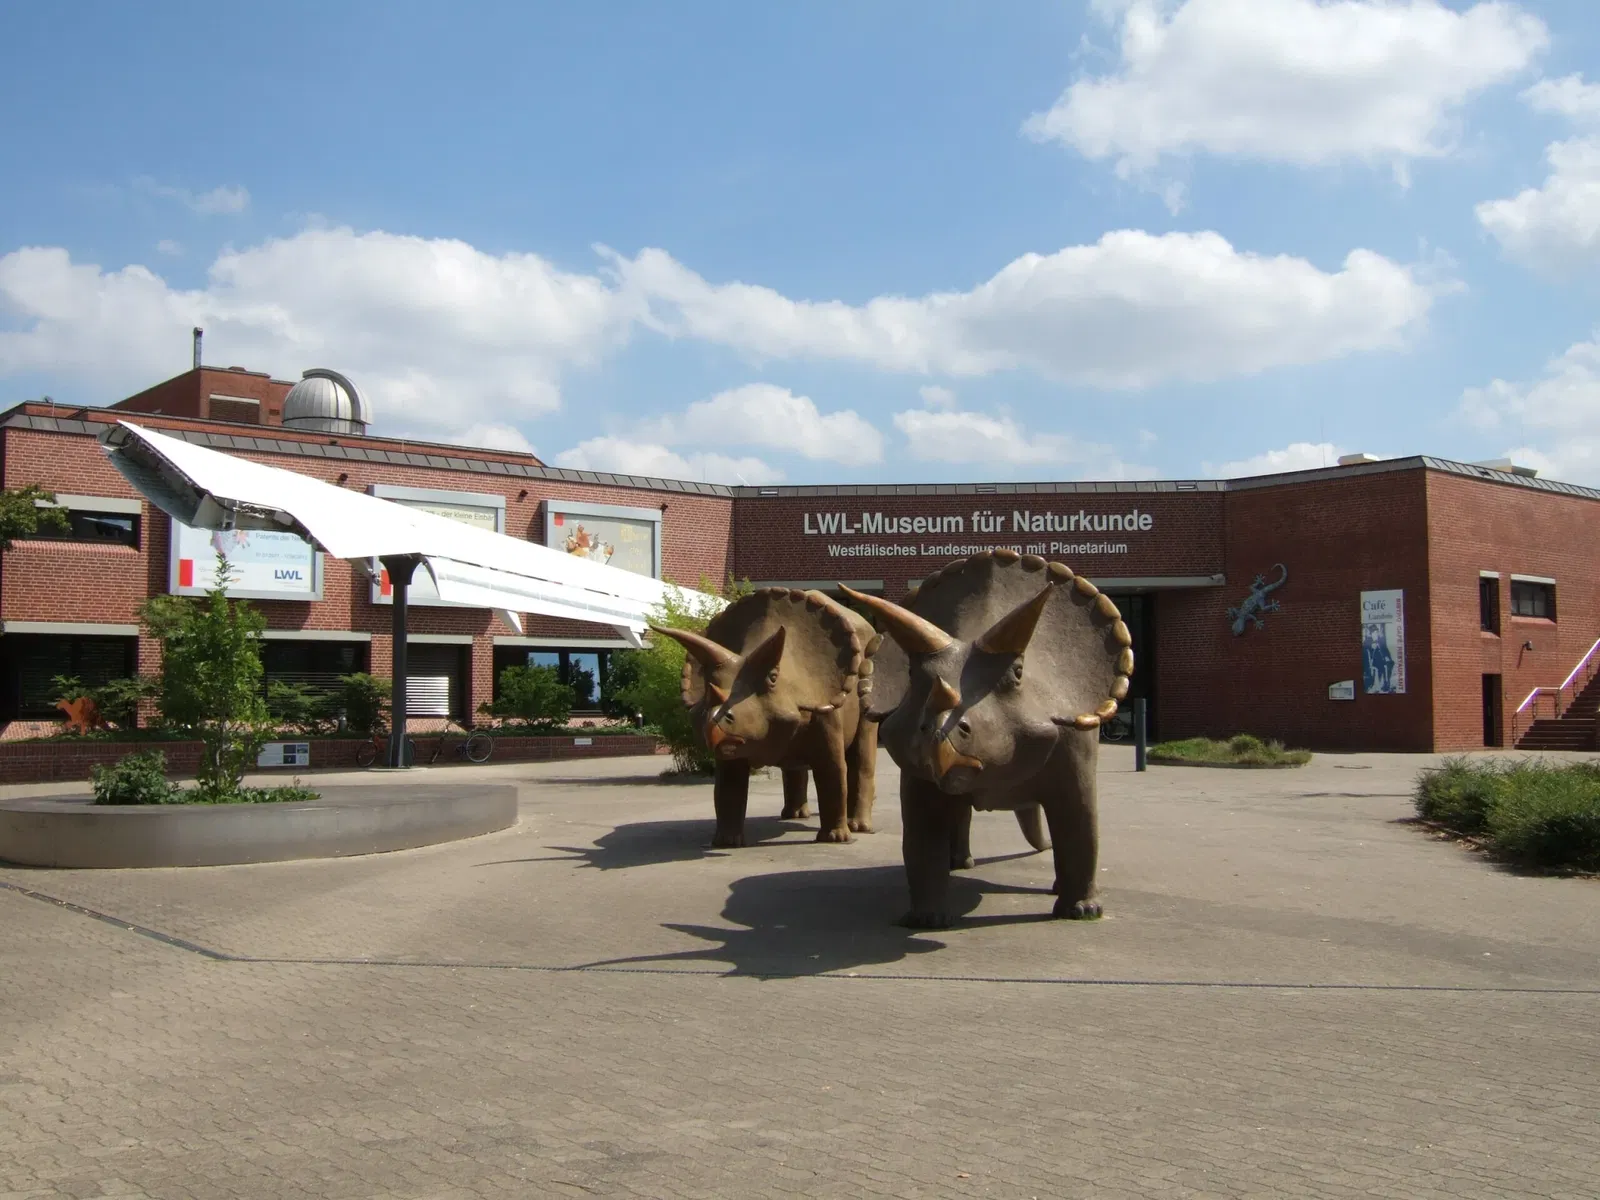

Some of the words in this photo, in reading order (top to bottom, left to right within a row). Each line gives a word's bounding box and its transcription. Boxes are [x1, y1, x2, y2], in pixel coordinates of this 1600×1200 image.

[803, 510, 964, 535] LWL-Museum
[972, 510, 1005, 533] für
[1012, 509, 1153, 532] Naturkunde
[828, 543, 917, 557] Westfälisches
[1026, 542, 1047, 555] mit
[1050, 541, 1128, 554] Planetarium
[274, 569, 303, 580] LWL
[1362, 600, 1387, 611] Café
